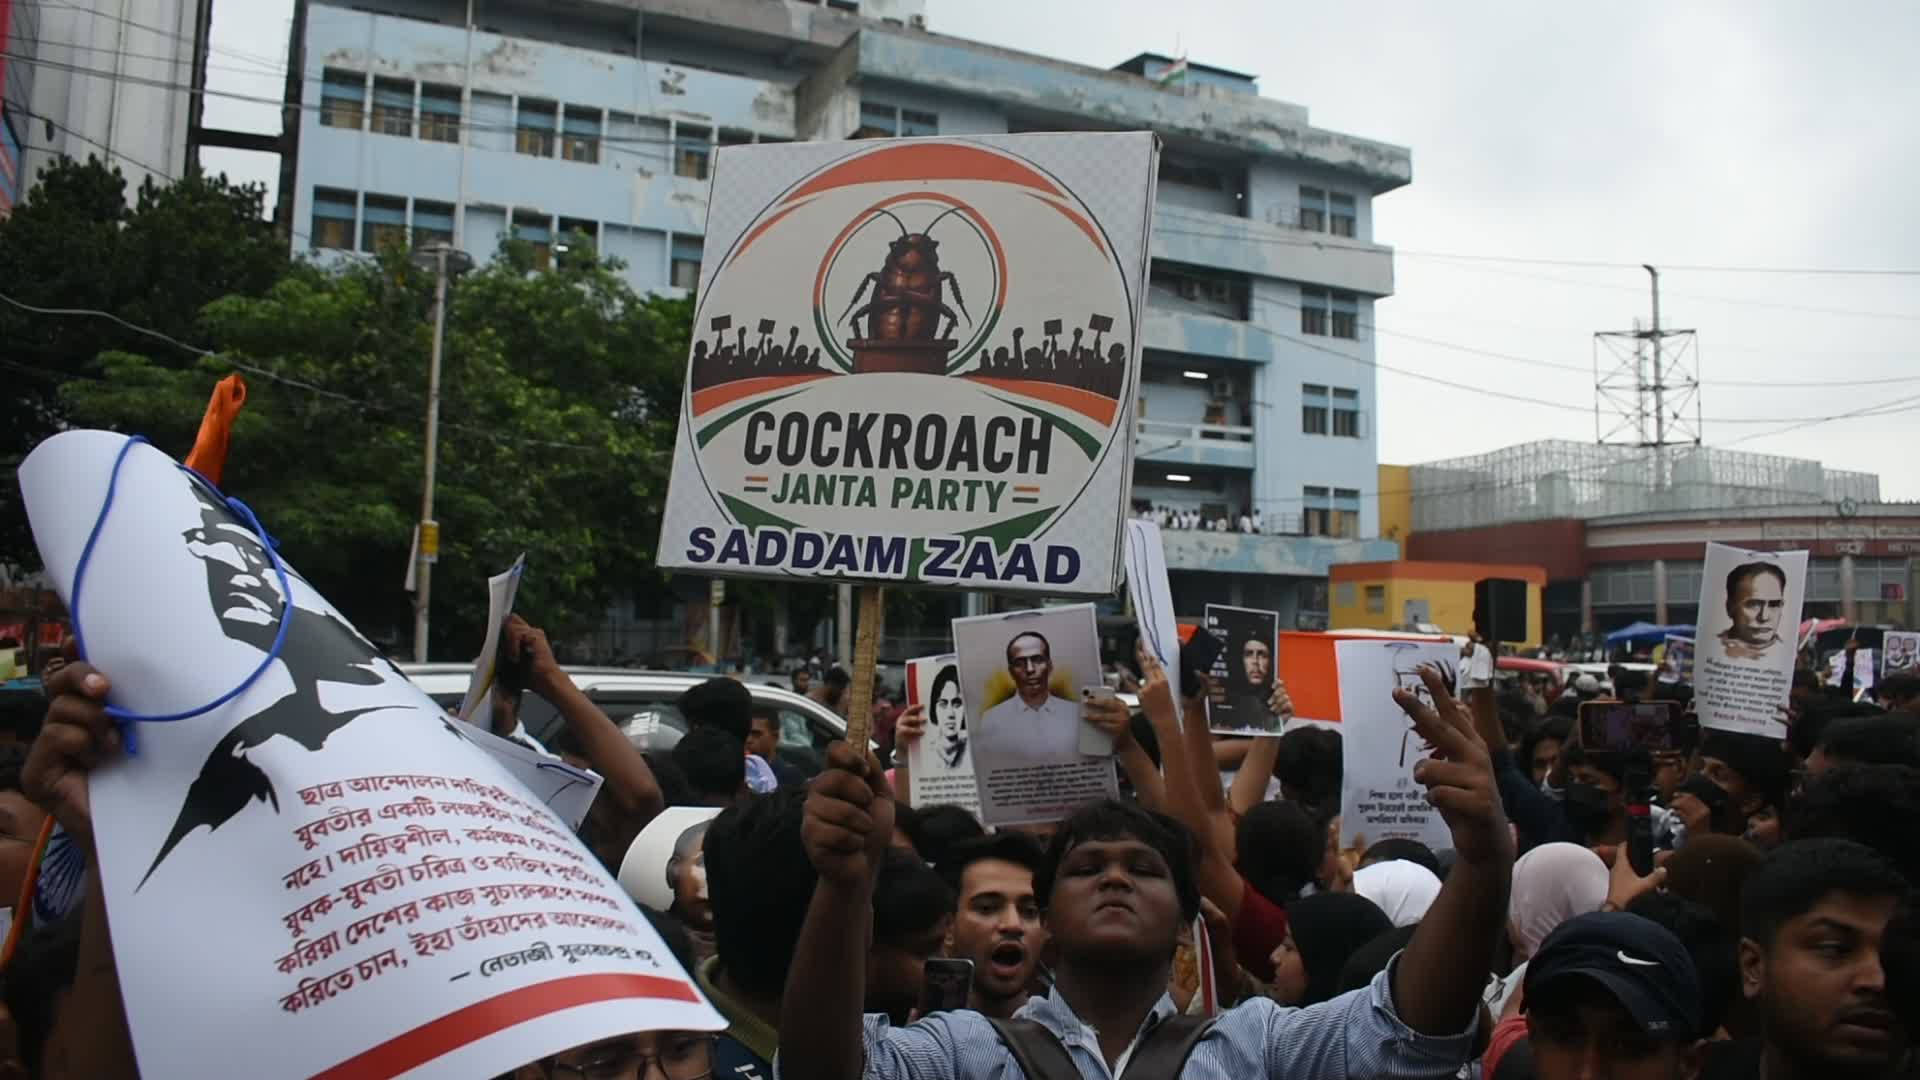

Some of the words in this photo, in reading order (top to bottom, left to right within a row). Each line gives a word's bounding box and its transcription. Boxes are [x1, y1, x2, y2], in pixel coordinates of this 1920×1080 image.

[744, 411, 1053, 474] COCKROACH
[771, 474, 877, 507] JANTA
[891, 477, 1008, 513] PARTY
[686, 526, 906, 575] SADDAM
[923, 538, 1081, 584] ZAAD
[297, 781, 343, 806] ছাত্র
[346, 775, 447, 796] আন্দোলন
[293, 806, 372, 851] যুবতীর
[378, 797, 436, 820] একটি
[283, 855, 334, 890] নহে।
[337, 825, 461, 865] দায়িত্বশীল,
[283, 863, 405, 938] যুবক-যুবতী
[408, 855, 468, 880] চরিত্র
[472, 856, 489, 871] ও
[275, 931, 341, 975] করিয়া
[346, 900, 421, 945] দেশের
[422, 886, 475, 914] কাজ
[480, 941, 554, 977] নেতাজী
[279, 968, 354, 1015] করিতে
[356, 948, 408, 981] চান,
[408, 927, 455, 957] ইহা
[456, 912, 549, 942] তাঁহাদের
